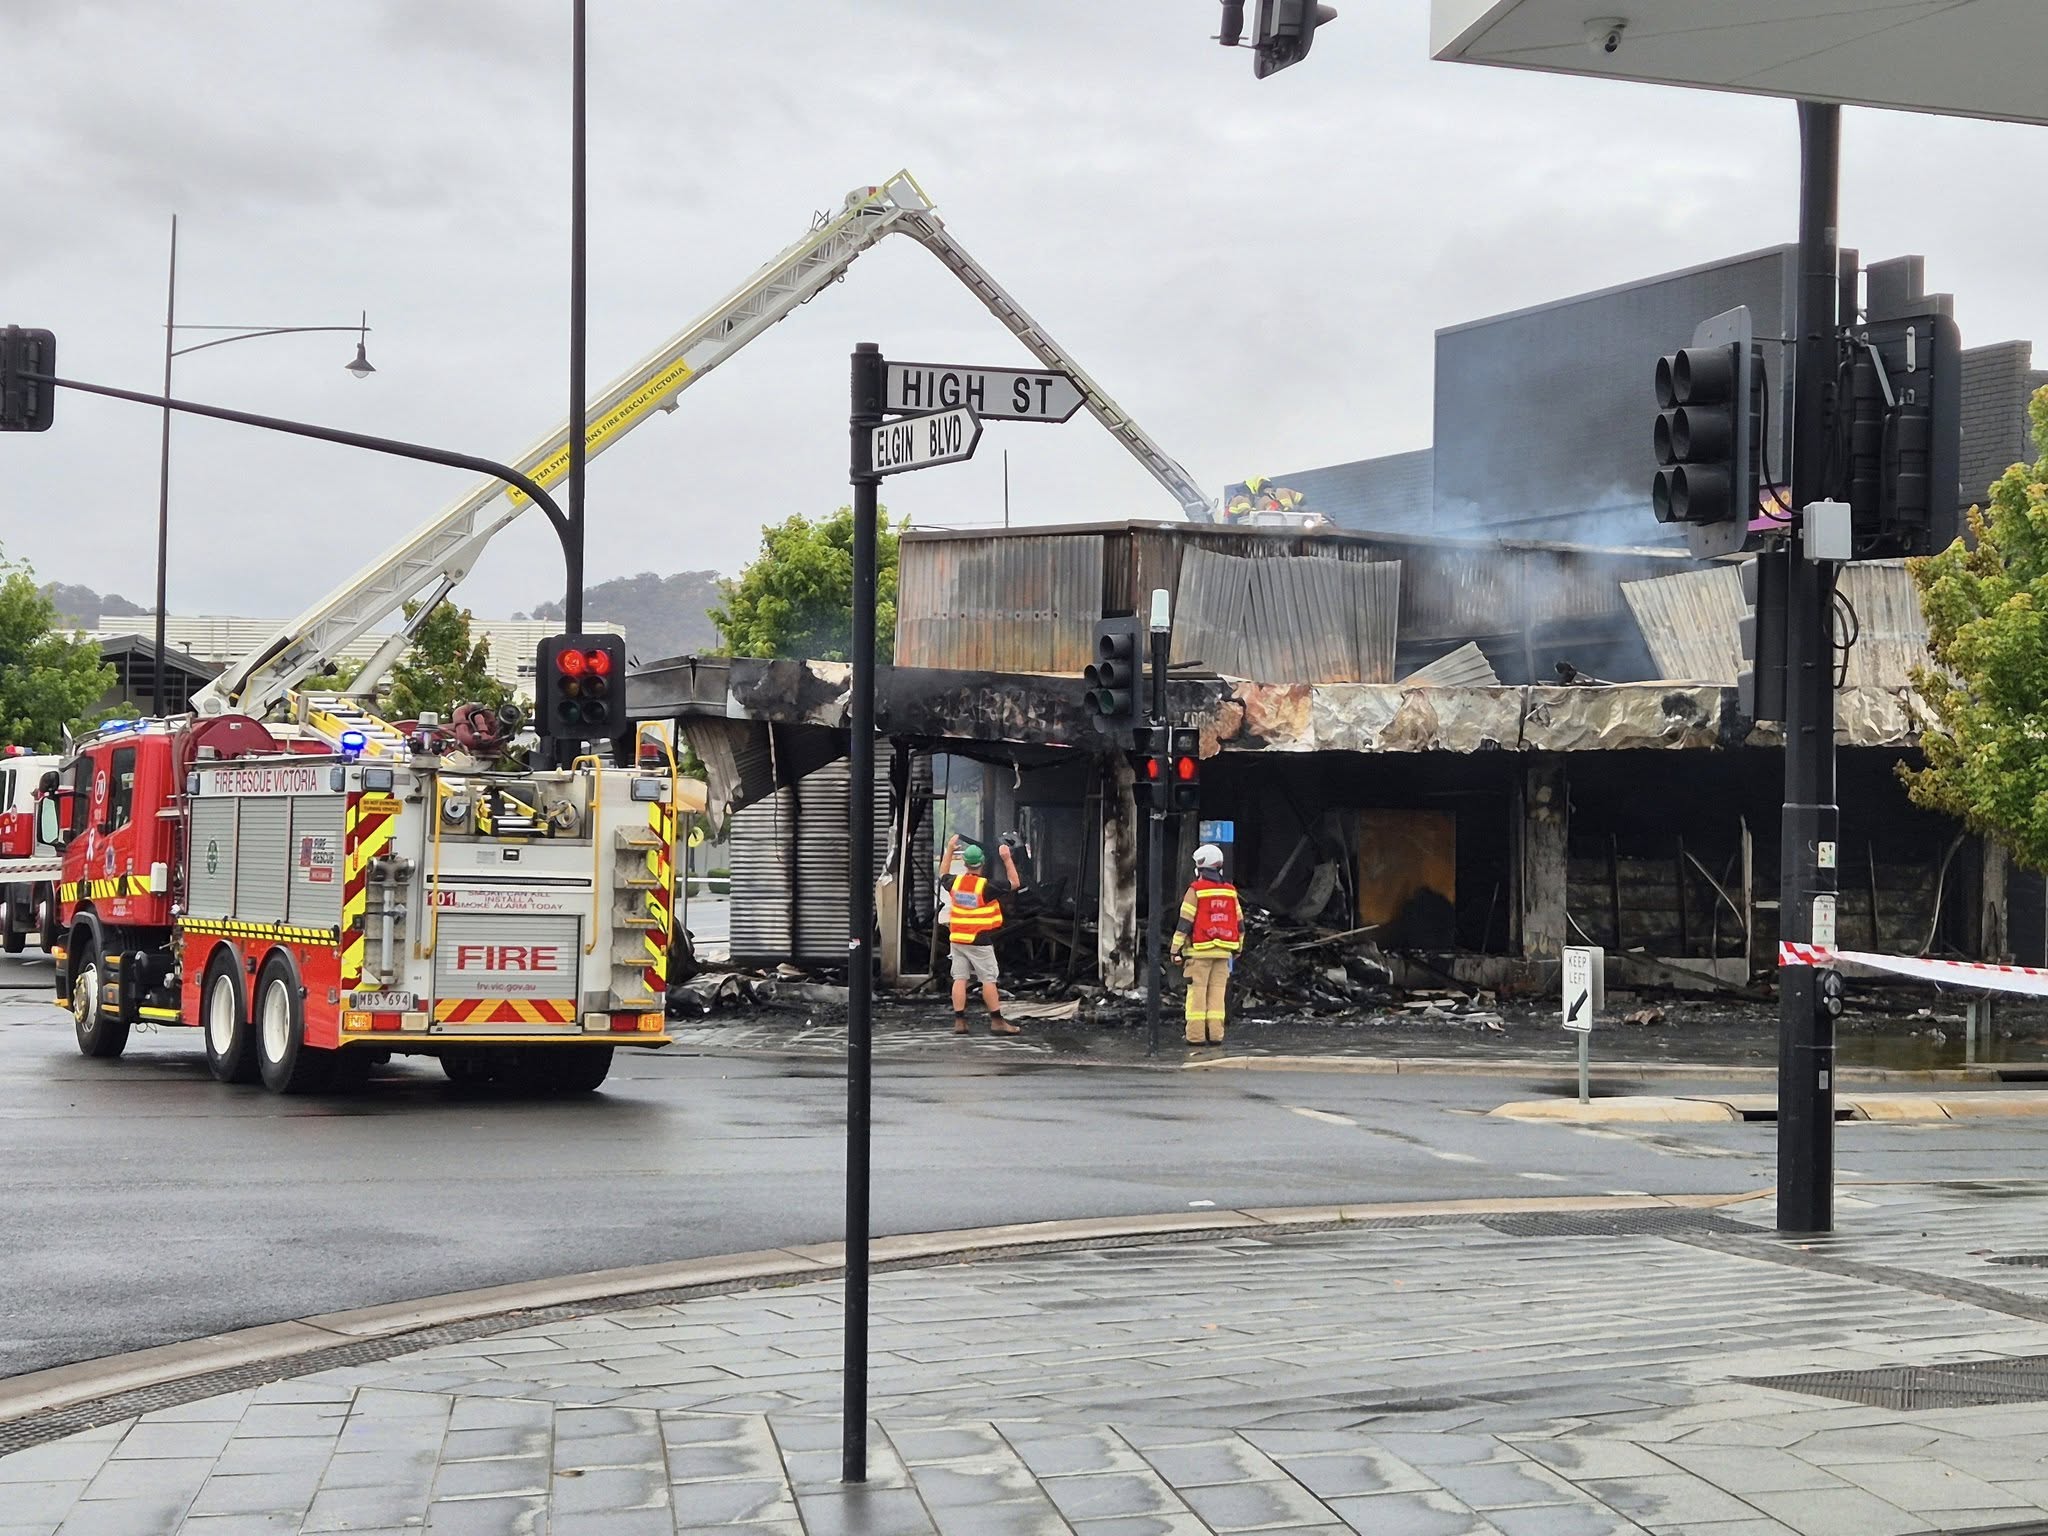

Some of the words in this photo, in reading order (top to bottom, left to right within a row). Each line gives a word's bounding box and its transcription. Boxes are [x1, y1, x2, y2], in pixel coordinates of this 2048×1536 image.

[602, 415, 620, 431] FIRE
[619, 393, 650, 418] RESCUE
[648, 367, 686, 395] VICTORIA
[902, 369, 985, 412] HIGH
[1012, 376, 1053, 414] ST
[877, 425, 914, 468] ELGIN
[929, 414, 962, 457] BLVD
[215, 772, 234, 793] FIRE
[235, 770, 271, 793] RESCUE
[273, 769, 317, 792] VICTORIA
[428, 891, 455, 906] 101
[457, 945, 558, 970] FIRE
[1568, 955, 1587, 968] KEEP
[477, 982, 536, 992] frv.vic.gov.au
[1569, 972, 1586, 984] LEFT
